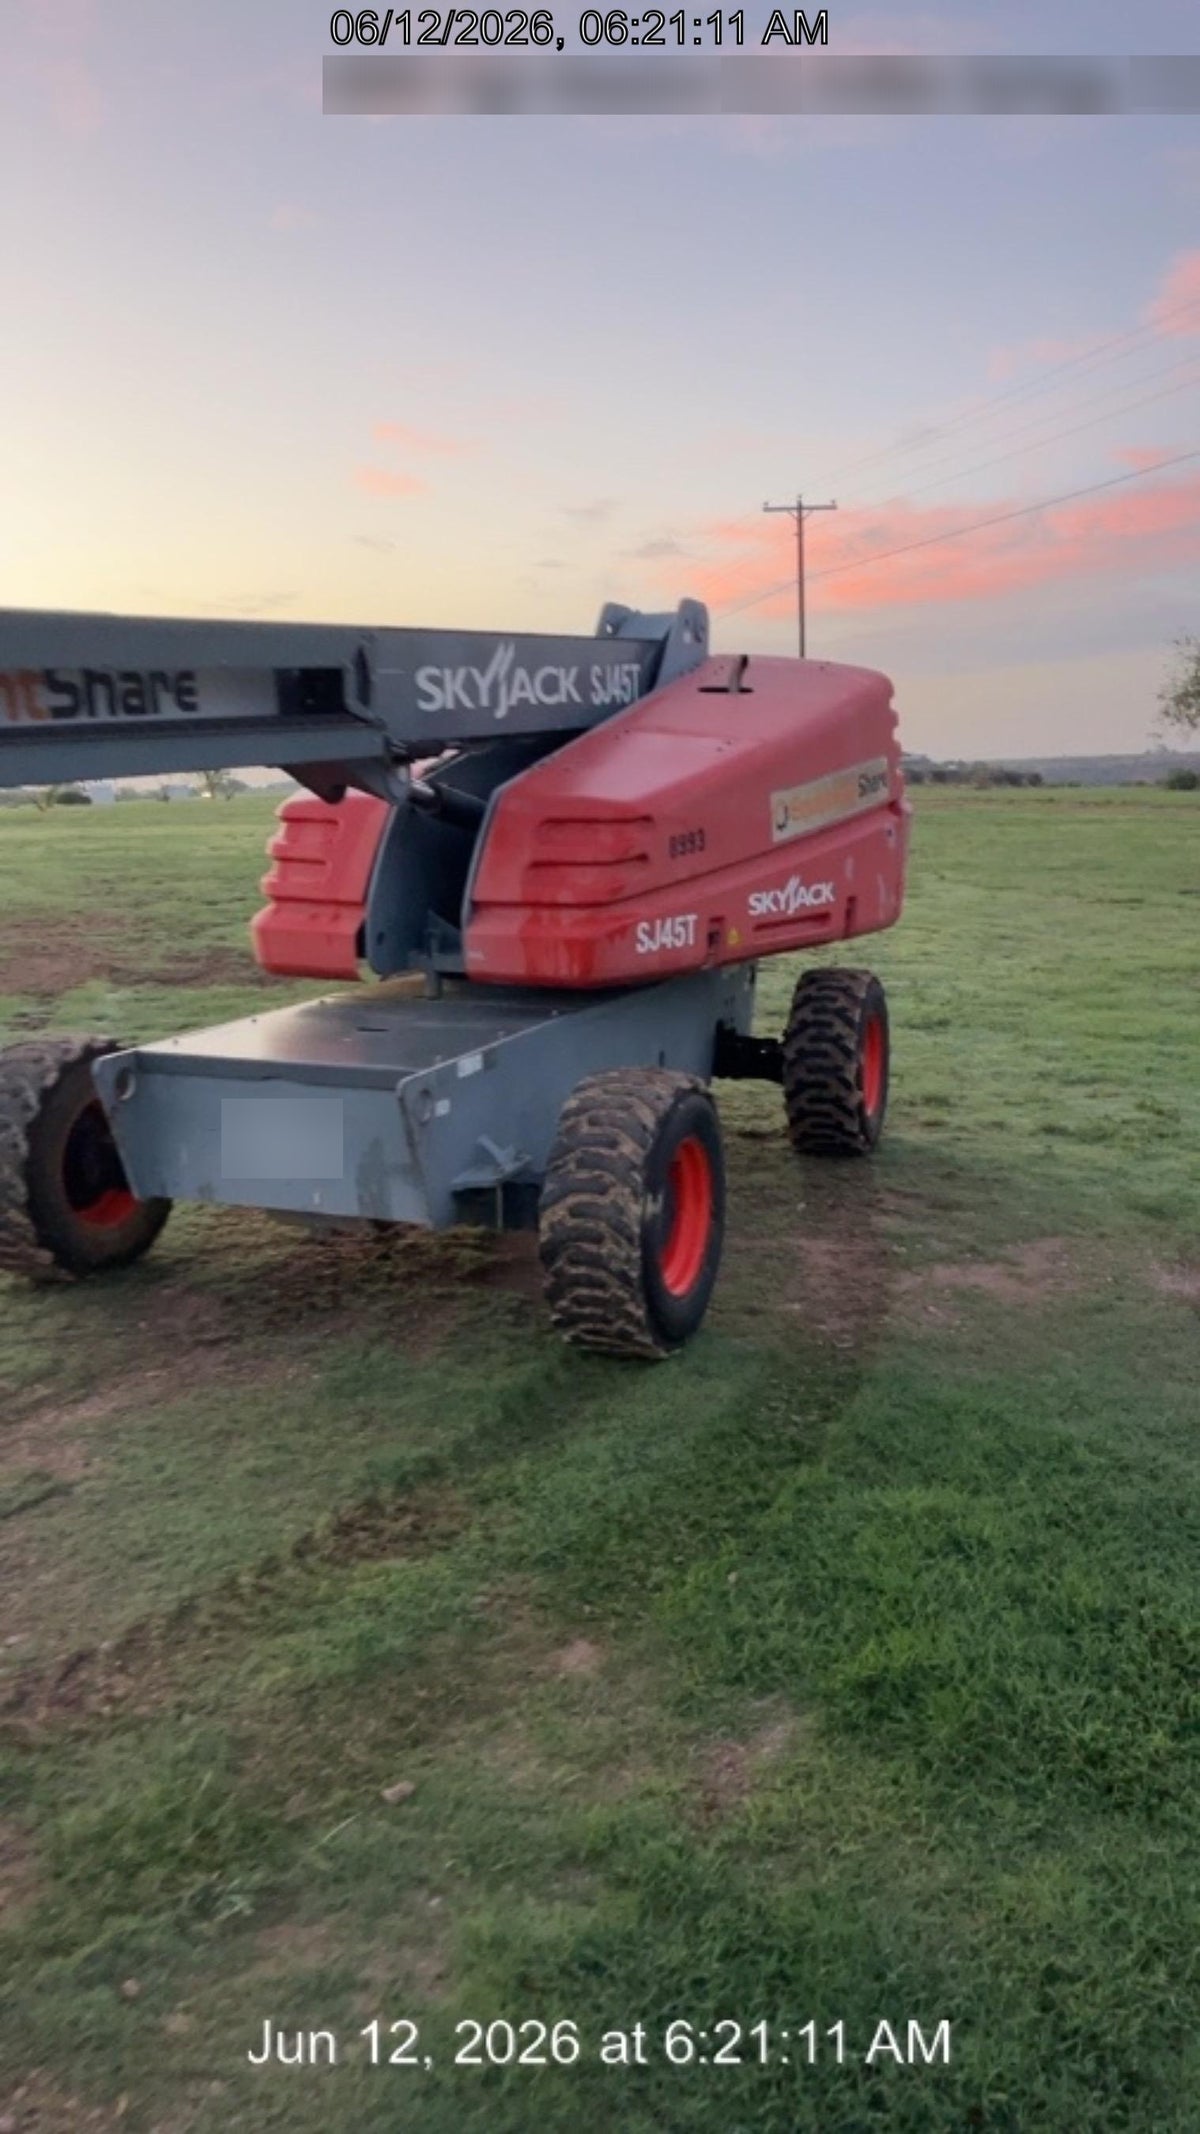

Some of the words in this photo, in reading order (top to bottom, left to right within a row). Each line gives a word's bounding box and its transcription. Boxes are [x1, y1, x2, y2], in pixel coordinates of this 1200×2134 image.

[415, 642, 581, 719] SKYJACK
[590, 662, 641, 705] SJ45T
[748, 875, 835, 916] SKYJACK
[636, 914, 698, 954] SJ45T
